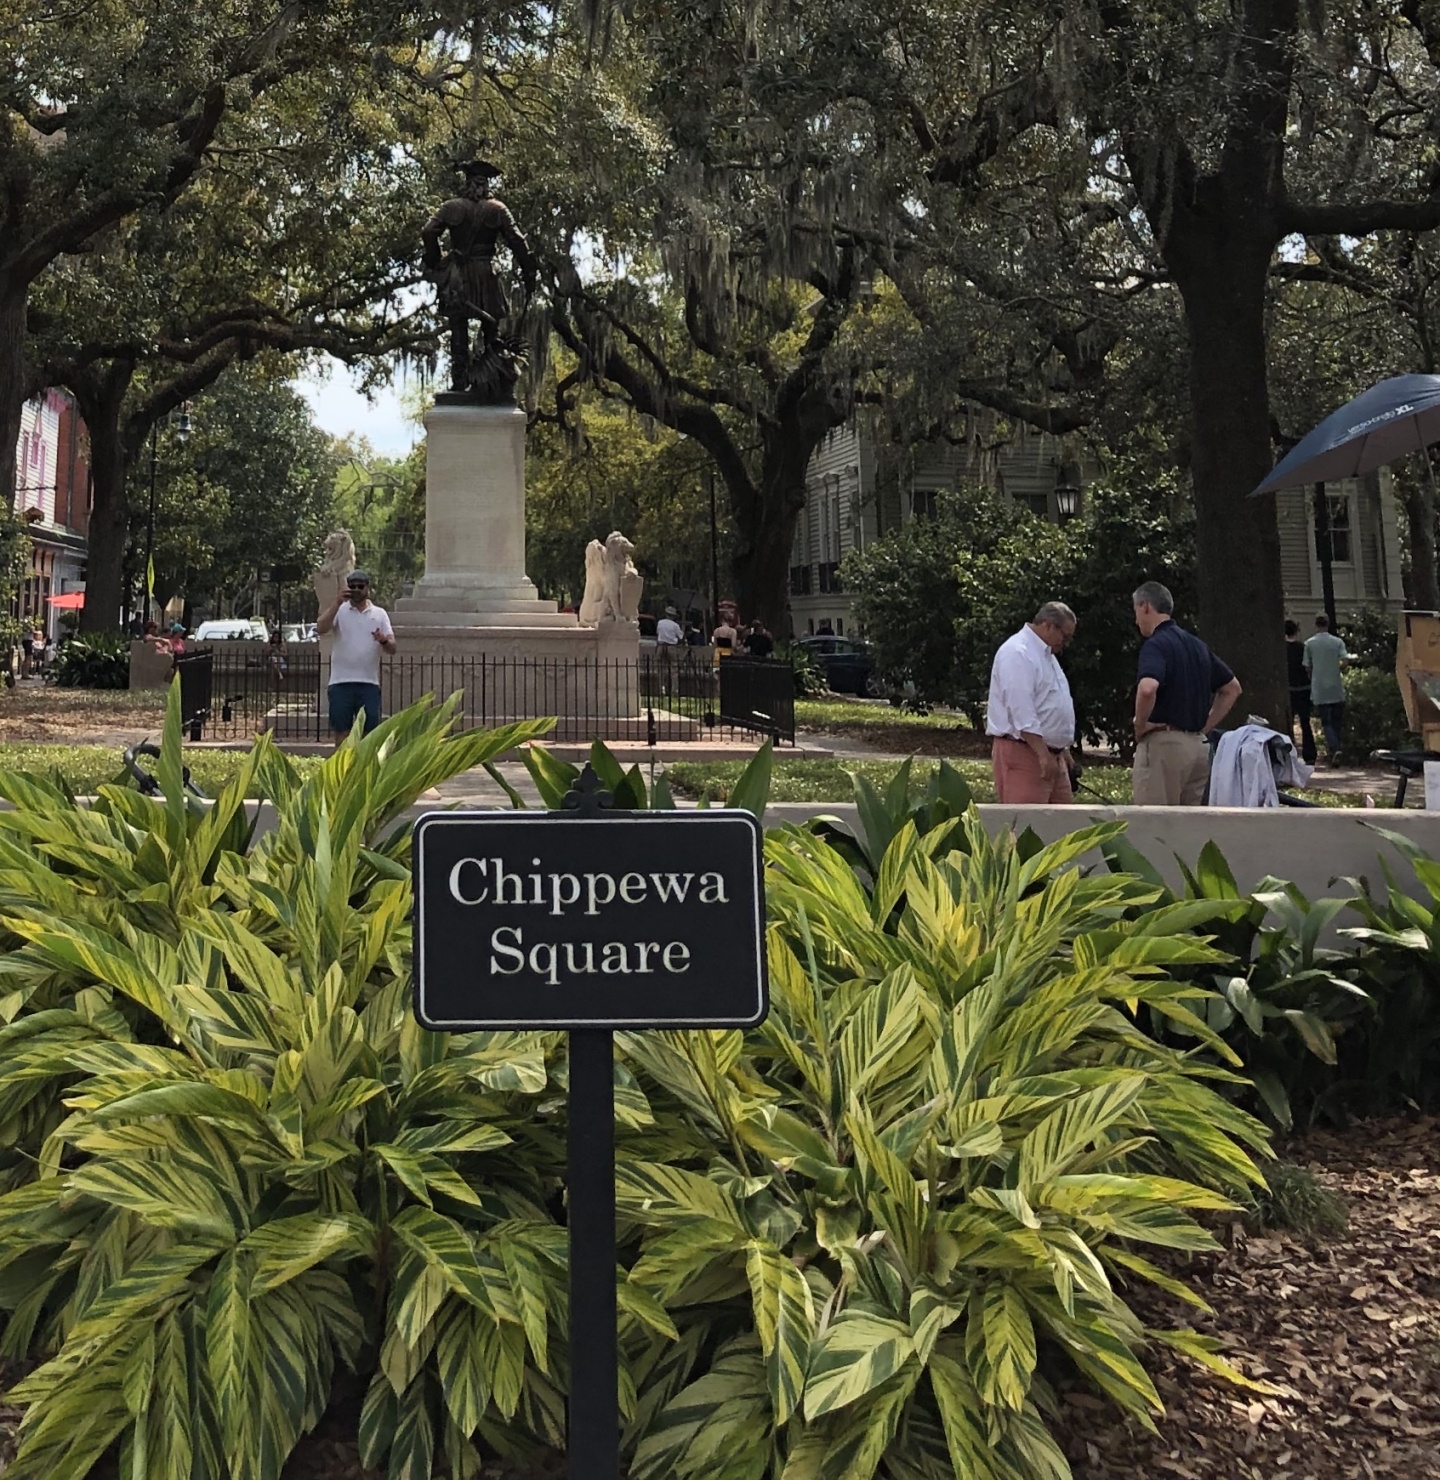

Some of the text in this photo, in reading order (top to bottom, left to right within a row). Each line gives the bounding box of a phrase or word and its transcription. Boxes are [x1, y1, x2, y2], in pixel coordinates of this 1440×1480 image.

[1395, 404, 1415, 416] XL
[449, 857, 730, 915] Chippewa
[489, 926, 691, 985] Square
